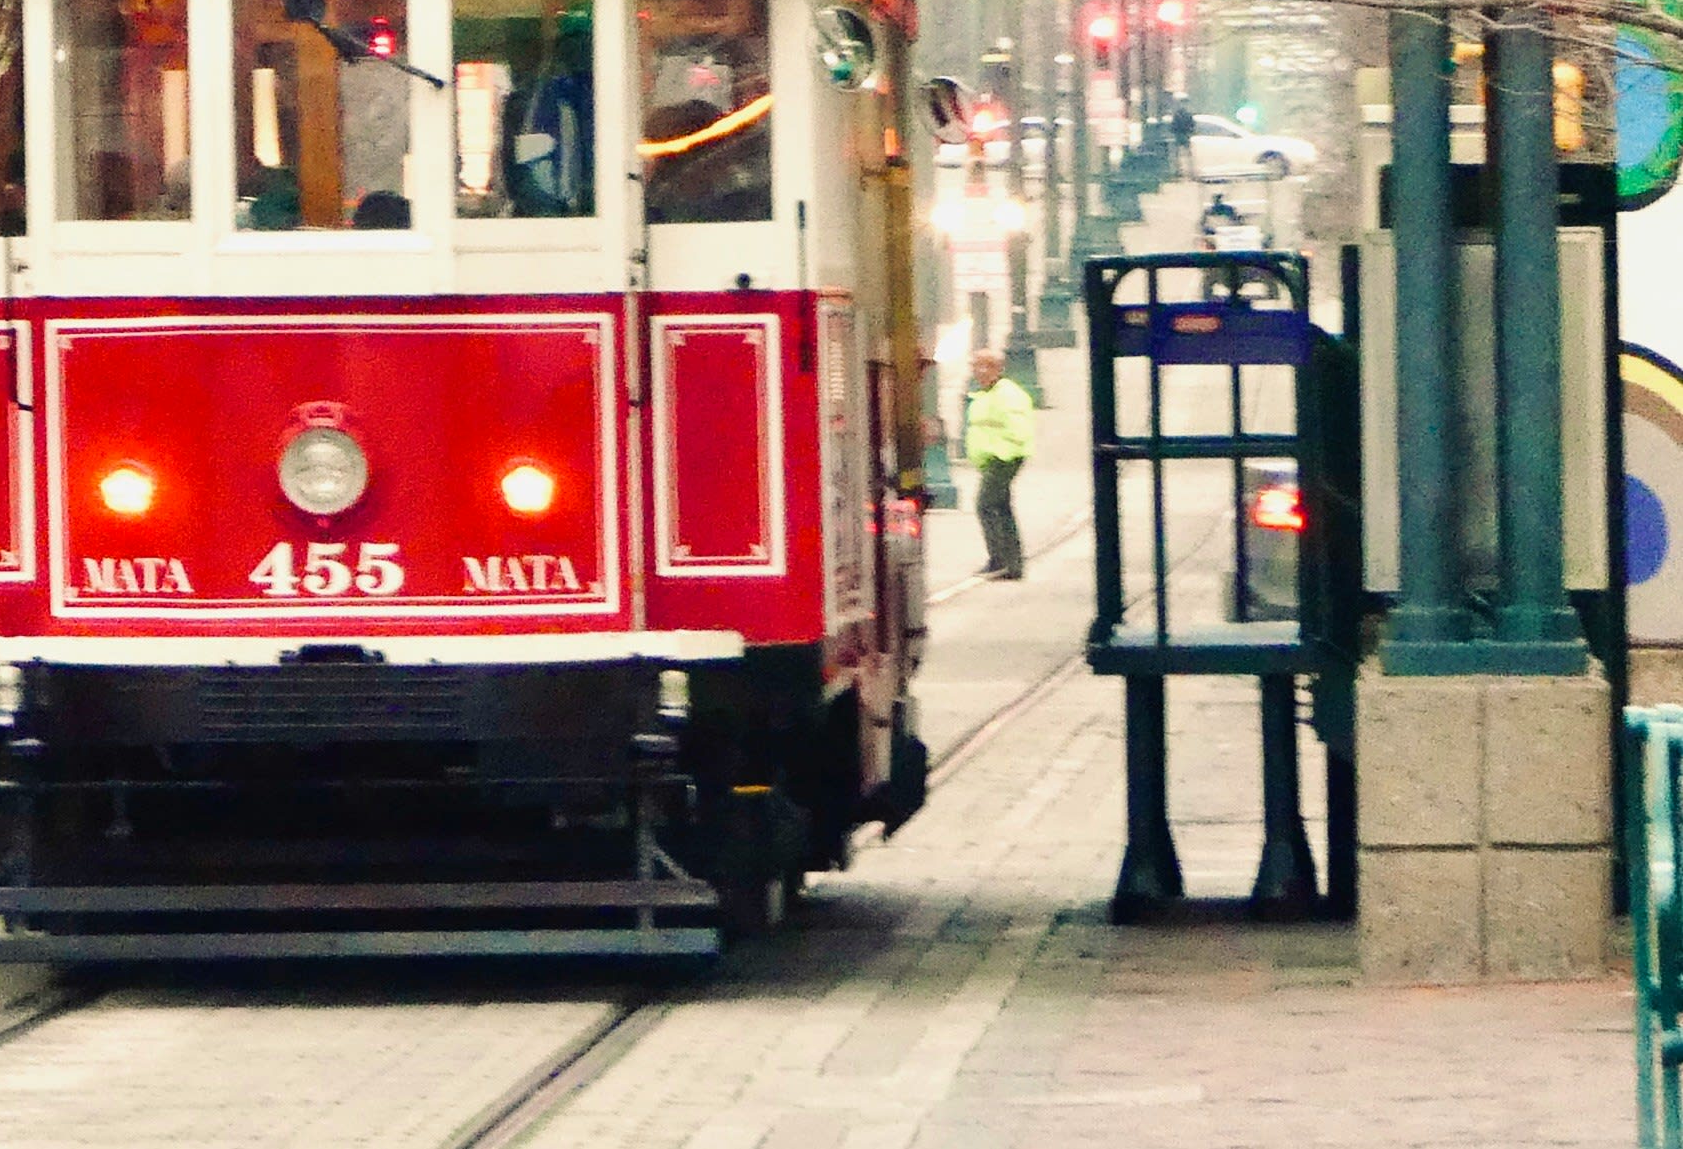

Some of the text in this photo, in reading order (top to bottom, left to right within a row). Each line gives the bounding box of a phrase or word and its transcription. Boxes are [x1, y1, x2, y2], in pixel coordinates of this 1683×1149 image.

[82, 556, 195, 593] MATA
[248, 541, 405, 596] 455
[461, 554, 582, 592] MATA
